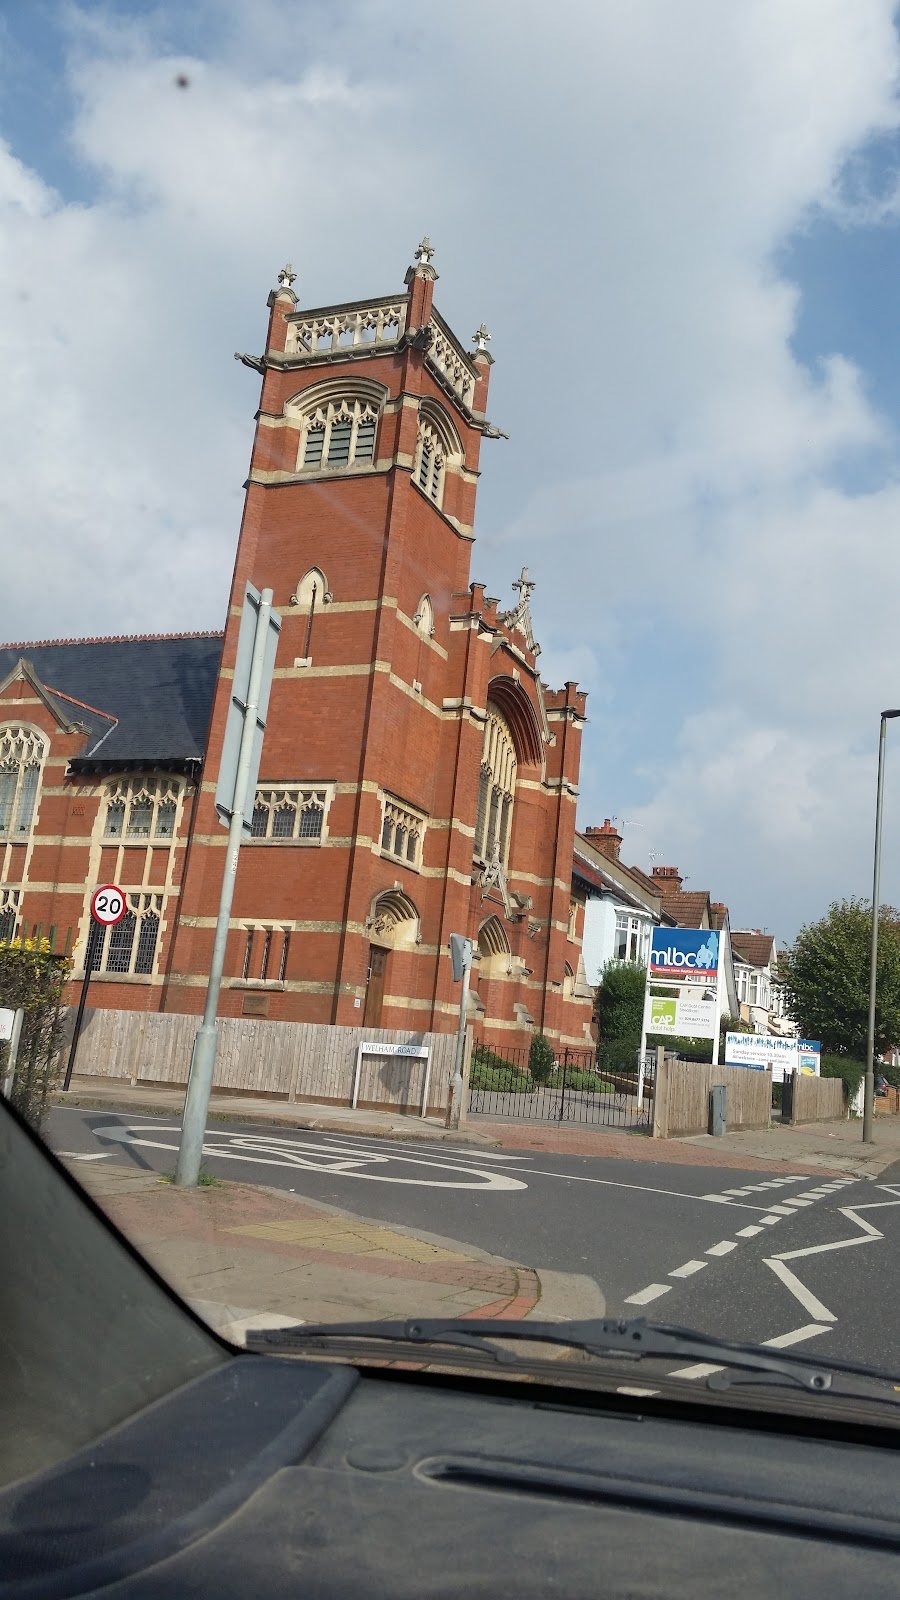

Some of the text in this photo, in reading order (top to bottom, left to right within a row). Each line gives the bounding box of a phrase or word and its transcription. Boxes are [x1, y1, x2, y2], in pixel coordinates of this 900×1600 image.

[97, 896, 121, 914] 20
[650, 947, 697, 968] mlbc
[652, 1015, 673, 1026] CAP
[365, 1044, 417, 1055] WELHAM ROAD
[797, 1043, 813, 1052] mlbc
